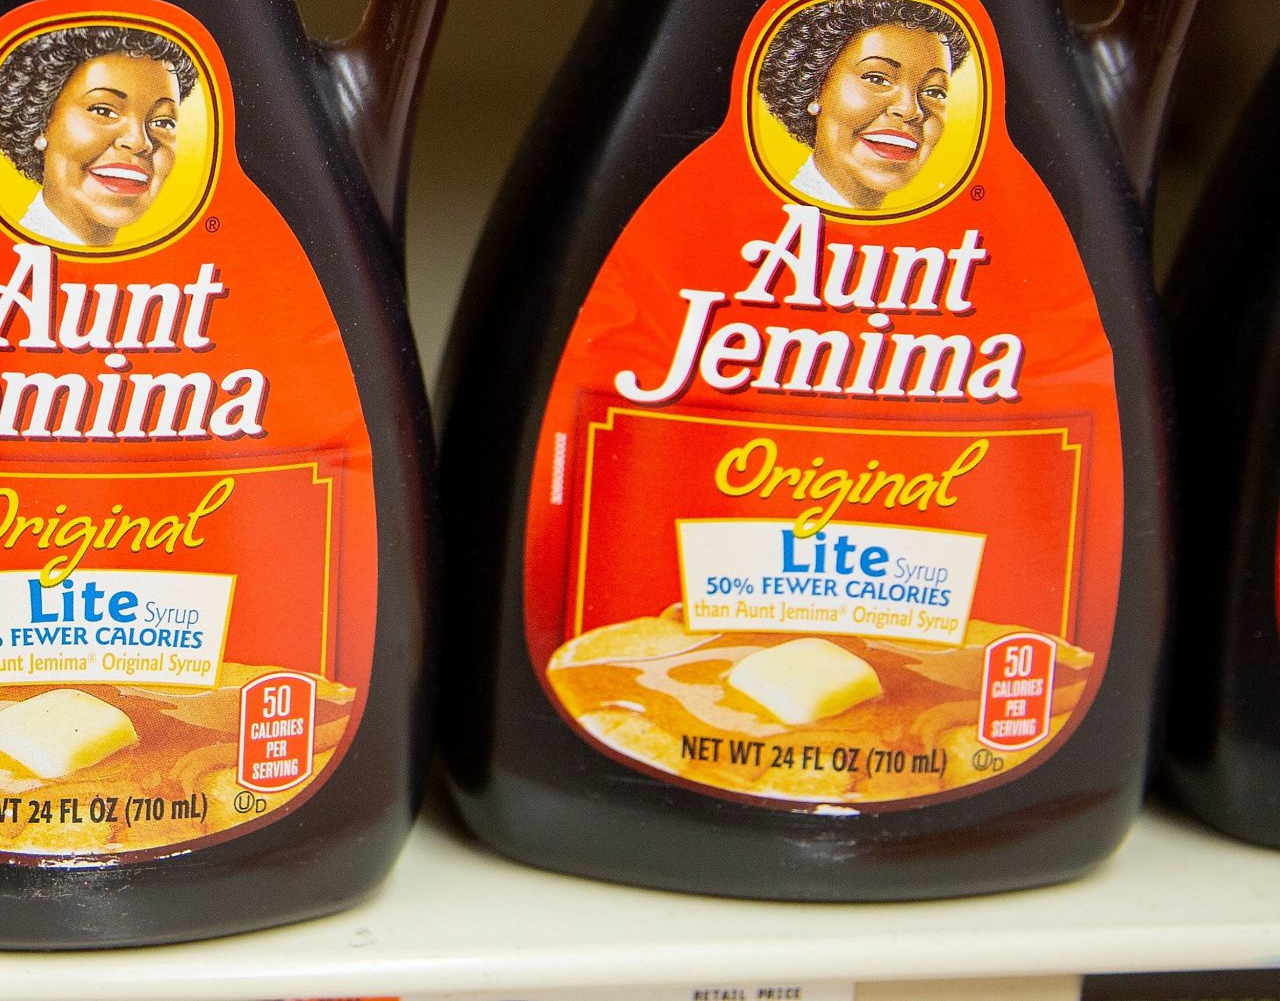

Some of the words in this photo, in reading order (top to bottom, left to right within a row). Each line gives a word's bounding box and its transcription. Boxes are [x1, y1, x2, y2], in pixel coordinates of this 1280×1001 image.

[736, 204, 991, 315] Aunt
[615, 289, 1025, 404] Jemima
[715, 437, 988, 538] Original
[781, 529, 889, 577] Lite
[894, 557, 948, 586] Syrup
[28, 579, 138, 623] Lite
[144, 601, 199, 628] Syrup
[706, 576, 753, 595] 50%
[762, 577, 837, 597] FEWER
[846, 580, 951, 607] CALORIES
[695, 601, 730, 619] than
[736, 601, 775, 619] Aunt
[853, 606, 913, 630] Original
[917, 609, 959, 633] Syrup
[11, 628, 87, 646] FEWER
[96, 628, 204, 649] CALORIES
[102, 653, 163, 675] Original
[168, 654, 211, 676] Syrup
[1003, 646, 1033, 678] 50
[263, 686, 291, 717] 50
[992, 675, 1043, 698] CALORIES
[1004, 699, 1026, 717] PER
[251, 716, 303, 740] CALORIES
[991, 717, 1036, 737] SERVING
[266, 740, 287, 758] PER
[681, 735, 723, 762] NET
[729, 740, 765, 766] WT
[770, 745, 795, 768] 24
[802, 746, 824, 771] FL
[832, 748, 860, 773] OZ
[867, 748, 905, 779] (710
[911, 748, 947, 778] mL)
[252, 758, 299, 779] SERVING
[28, 801, 53, 823] 24
[60, 799, 82, 823] FL
[90, 797, 119, 823] OZ
[125, 797, 165, 828] (710
[171, 793, 207, 822] mL)
